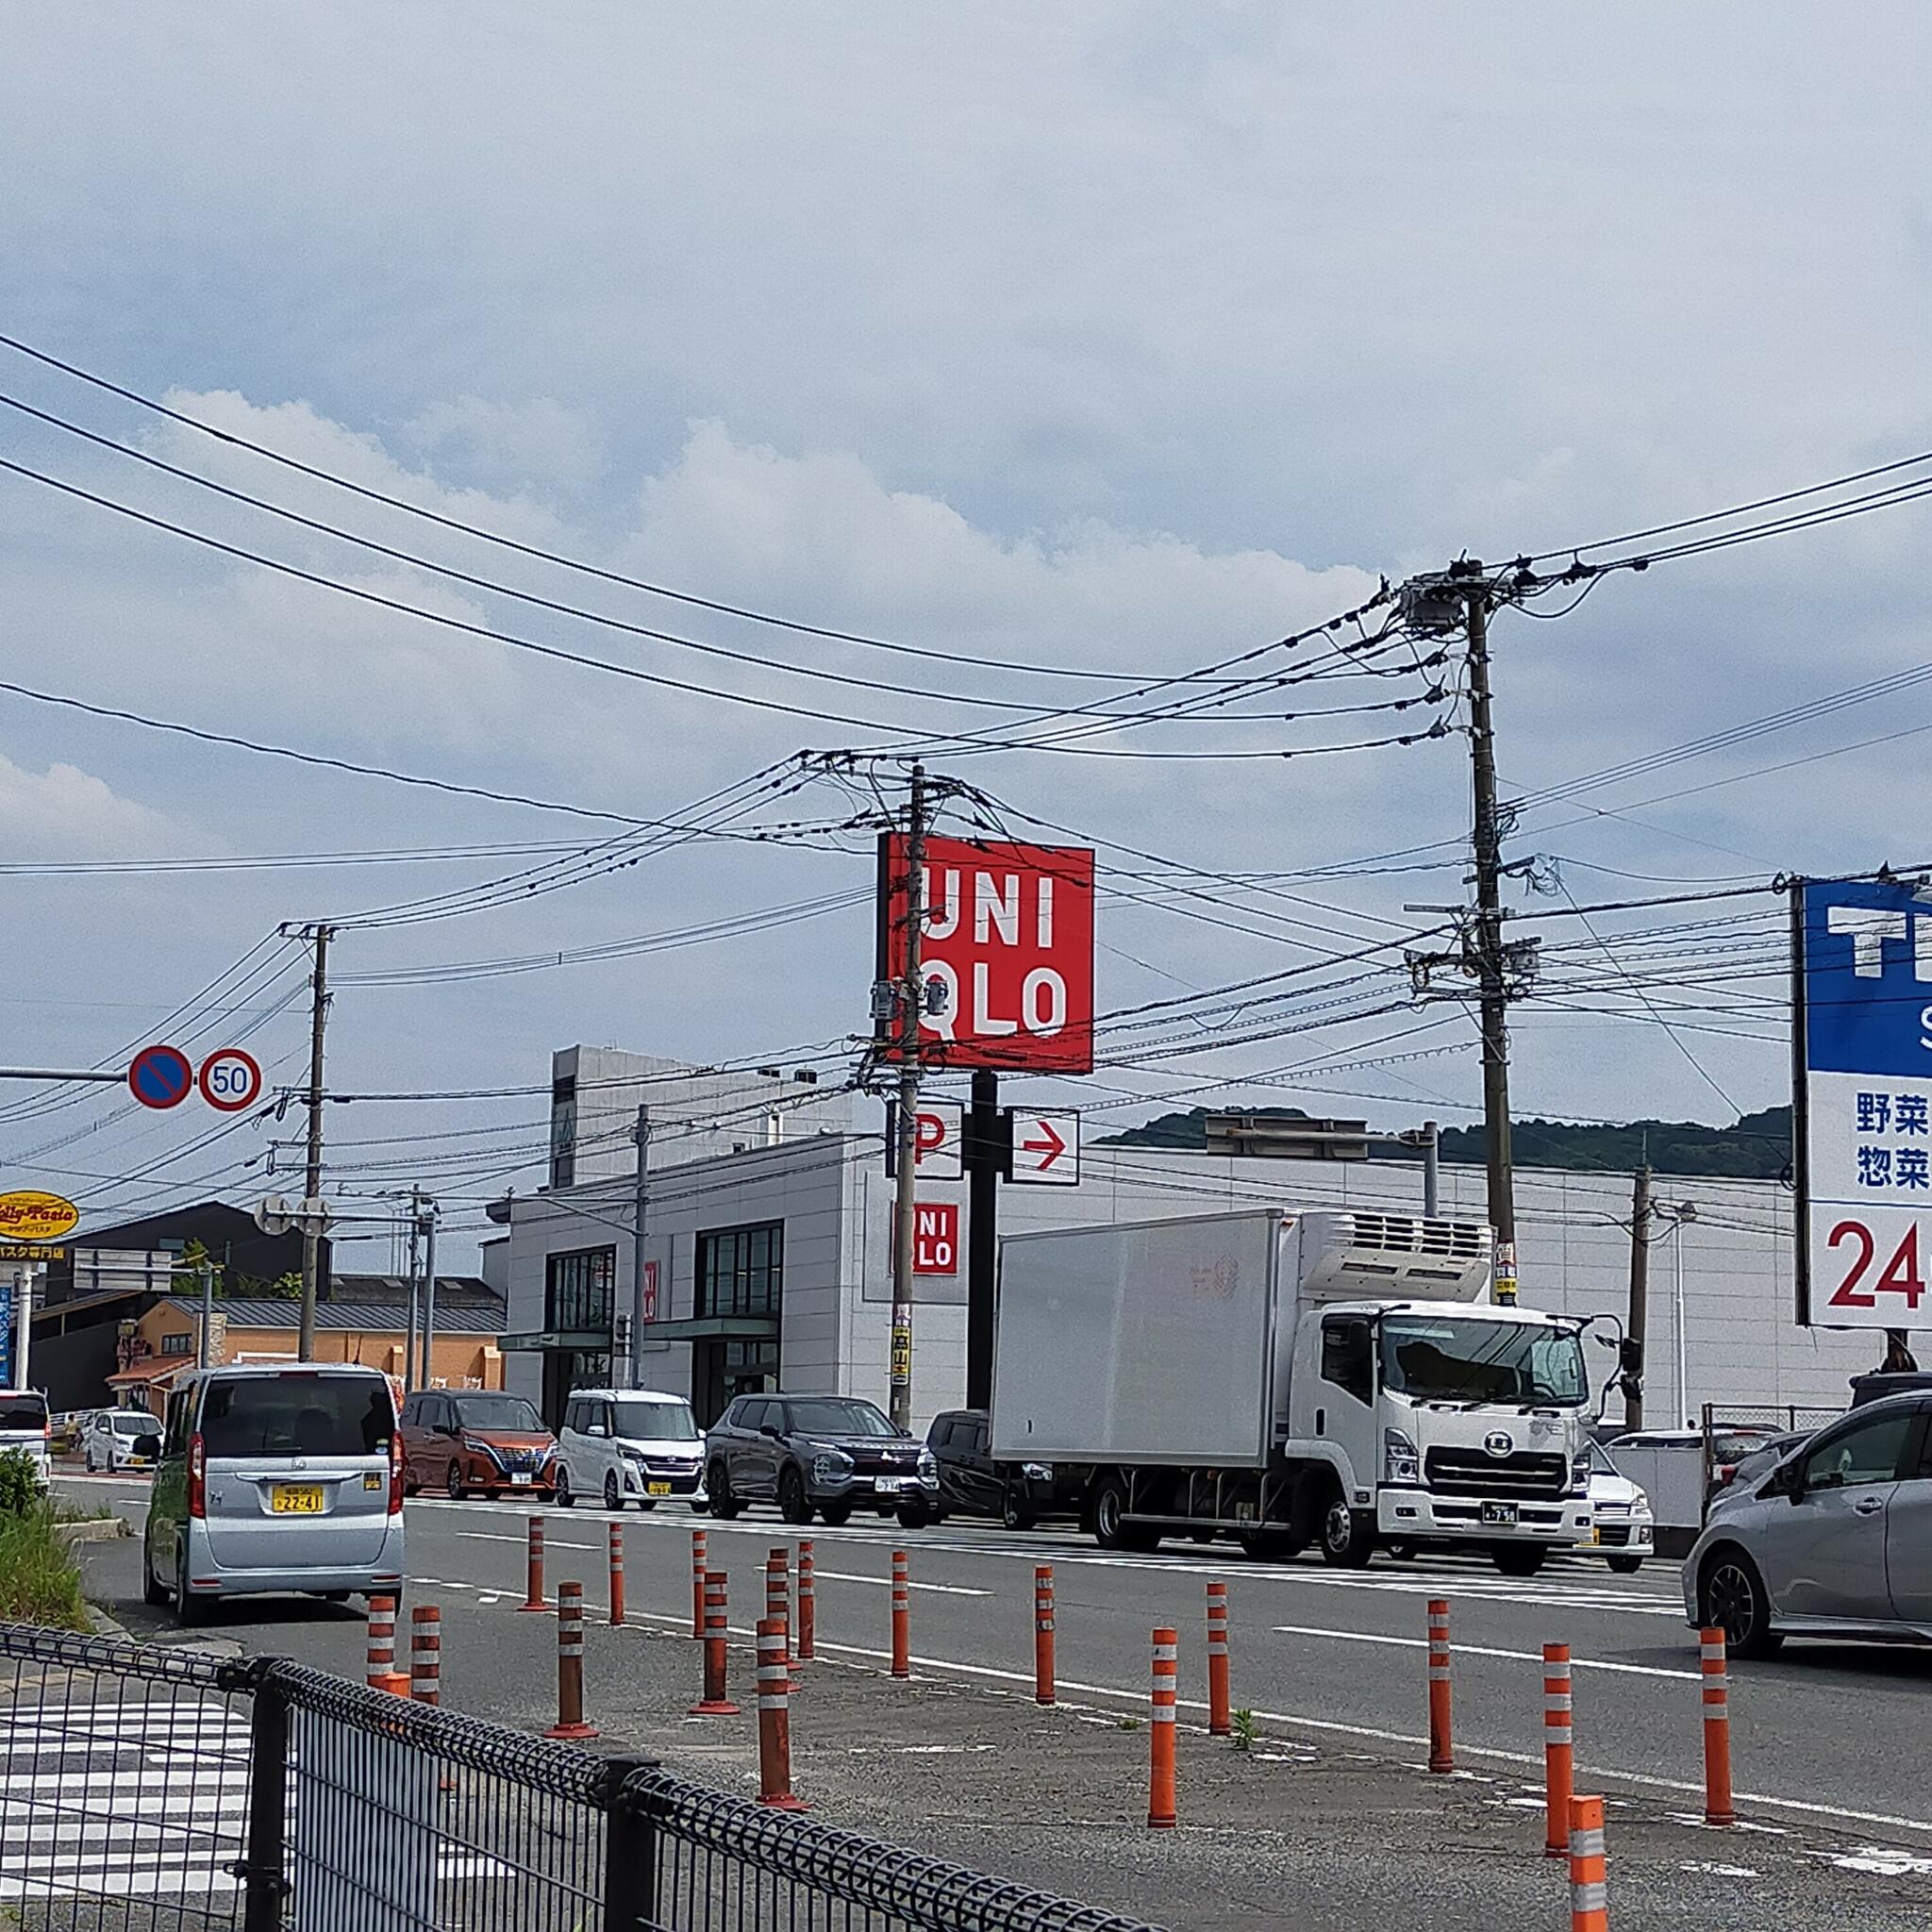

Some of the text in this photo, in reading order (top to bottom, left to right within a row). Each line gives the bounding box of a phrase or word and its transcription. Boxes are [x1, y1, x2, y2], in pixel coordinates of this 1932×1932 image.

[920, 867, 1053, 949] UNI
[1827, 906, 1932, 983] T
[918, 958, 1067, 1041] QLO
[212, 1065, 247, 1094] 50
[1856, 1091, 1929, 1136] 野菜
[914, 1113, 945, 1165] P
[1857, 1144, 1930, 1190] 惣菜
[0, 1204, 74, 1225] olly-Pasta
[919, 1211, 947, 1238] NI
[918, 1241, 952, 1266] LO
[1827, 1220, 1926, 1309] 24
